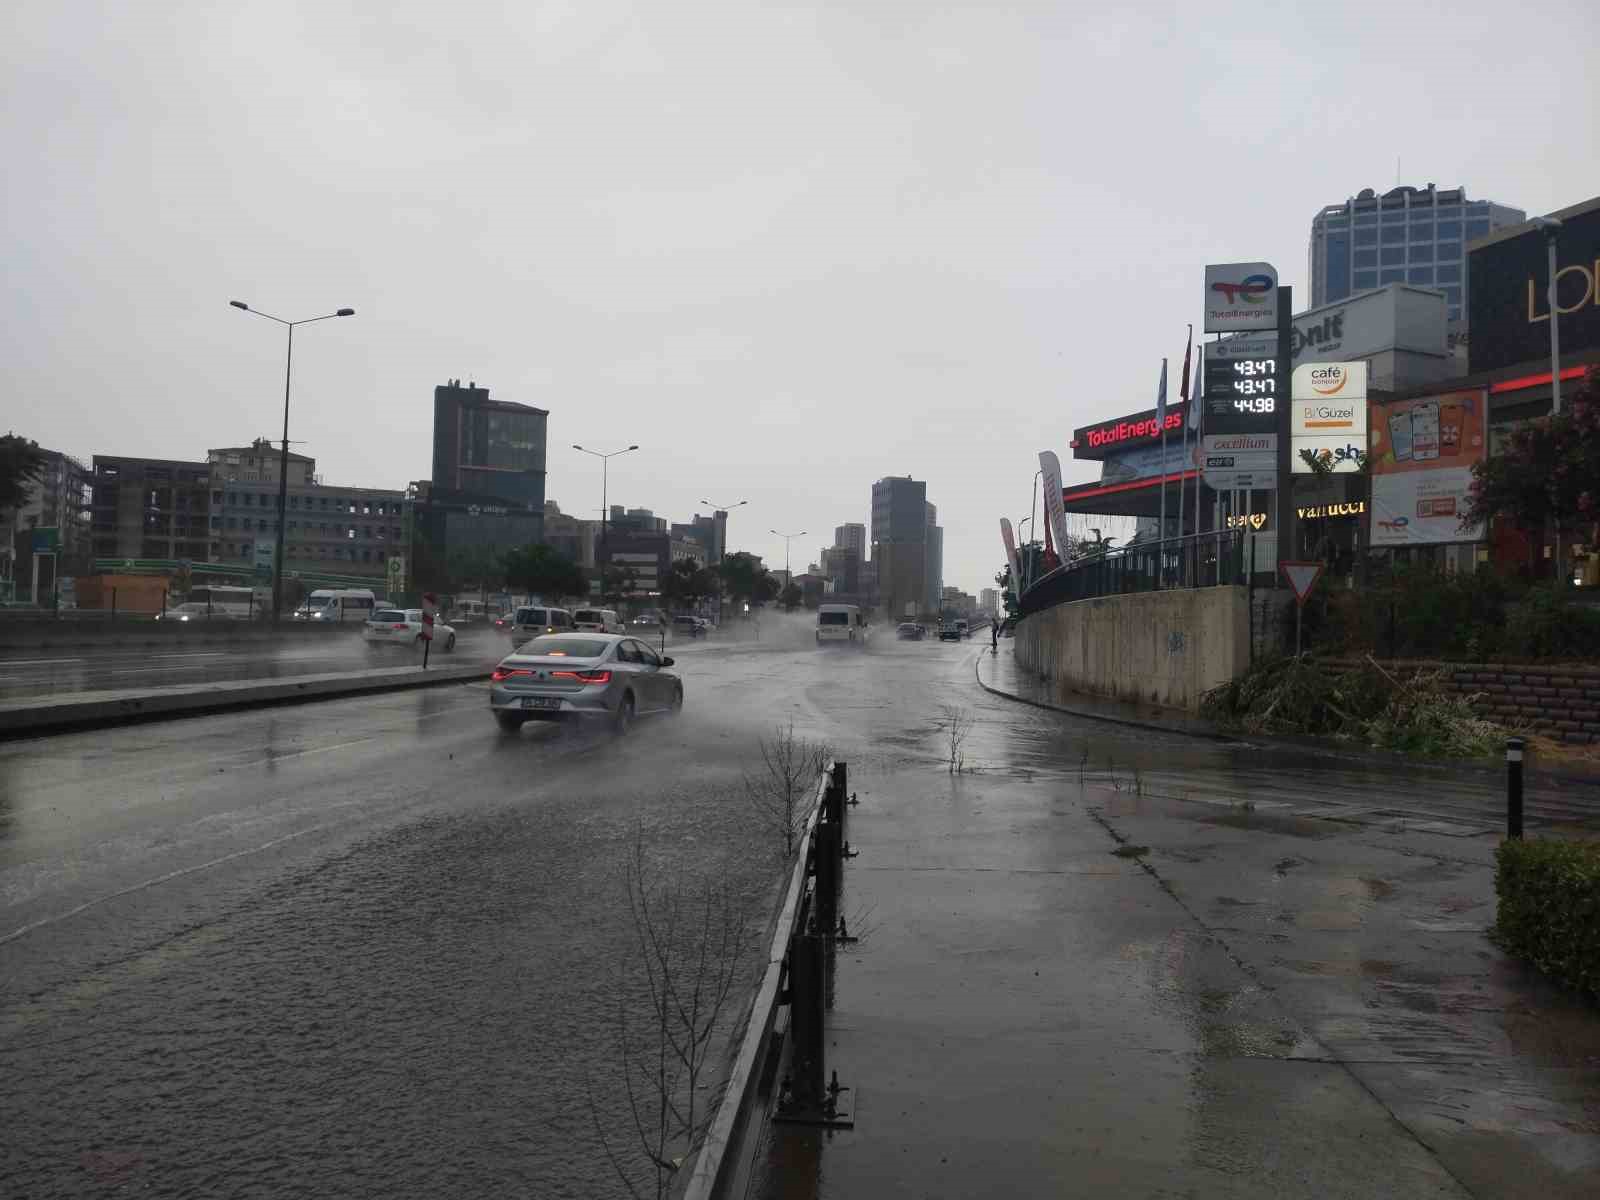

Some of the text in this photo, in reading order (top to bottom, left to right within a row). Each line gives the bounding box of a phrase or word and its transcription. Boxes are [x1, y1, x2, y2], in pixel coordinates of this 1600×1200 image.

[1528, 258, 1600, 324] LO
[1234, 360, 1275, 375] 43.47
[1311, 366, 1341, 378] café
[1234, 379, 1275, 394] 43.47
[1234, 398, 1275, 413] 44.98
[1087, 412, 1182, 448] TotalEnerges
